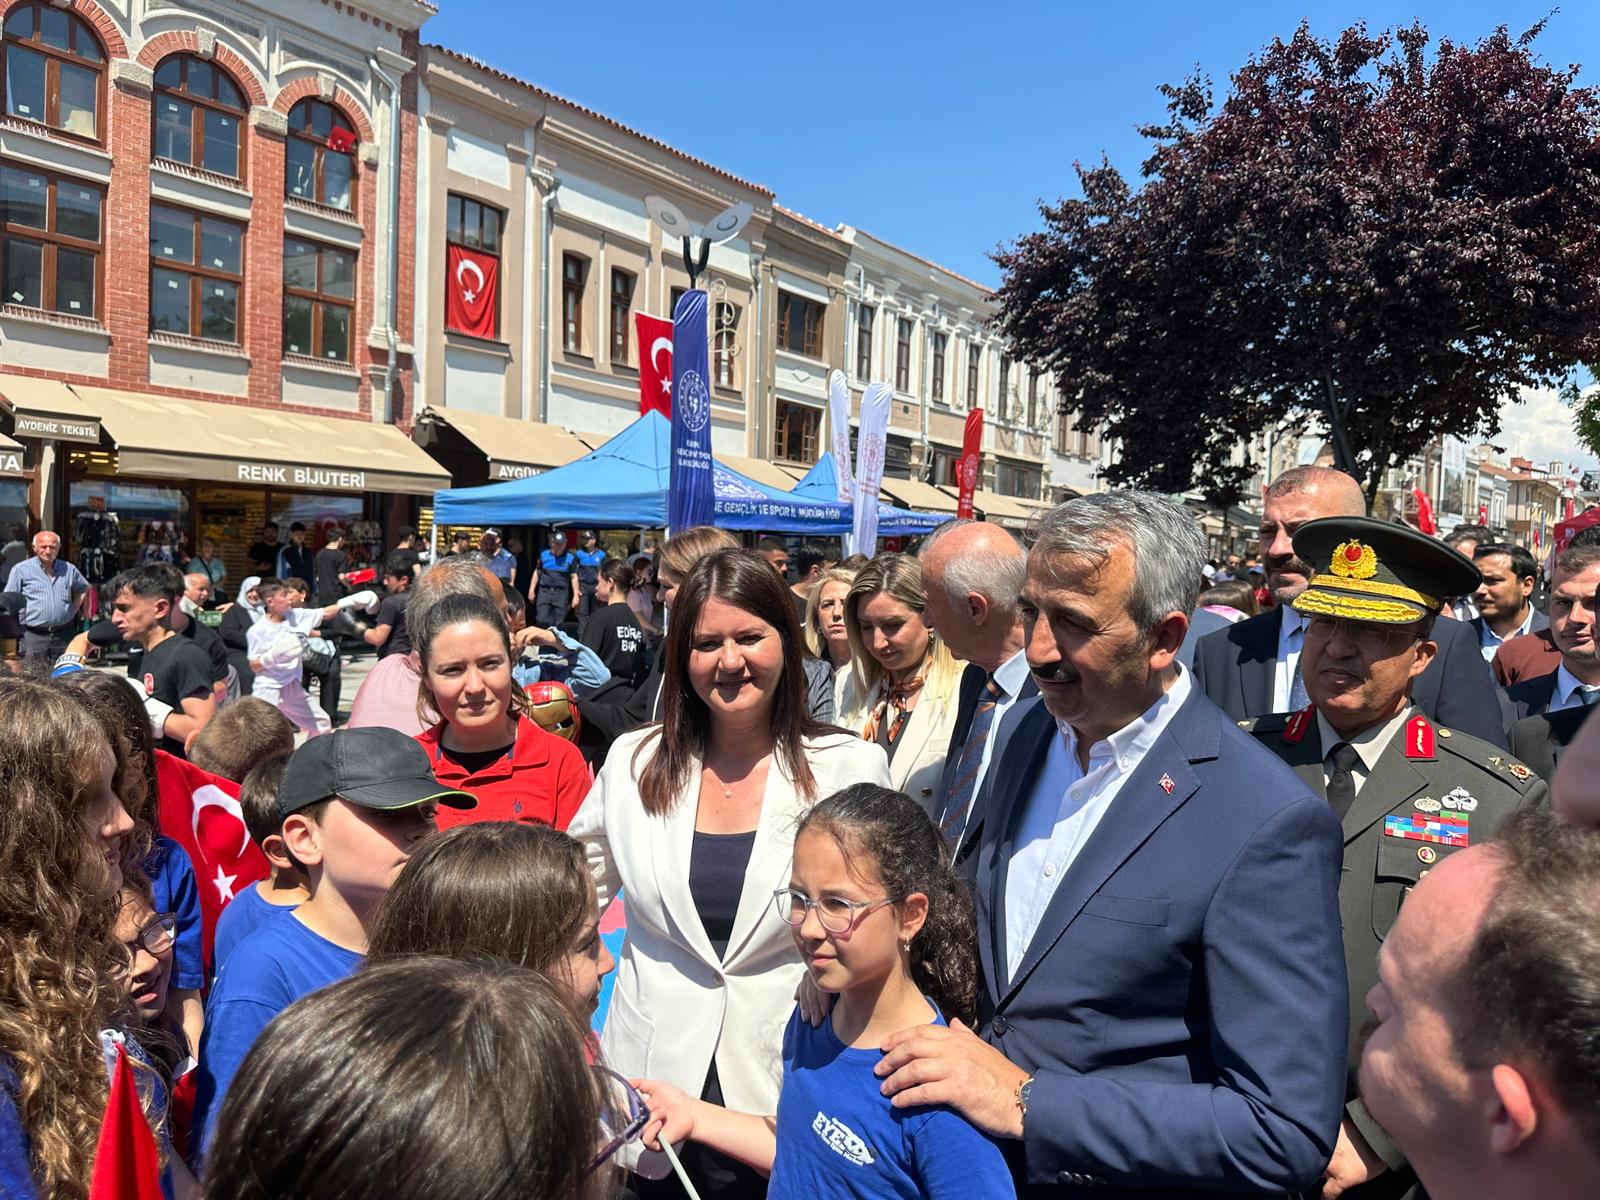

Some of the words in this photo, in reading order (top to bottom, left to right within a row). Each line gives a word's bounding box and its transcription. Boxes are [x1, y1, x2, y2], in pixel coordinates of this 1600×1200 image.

[18, 420, 58, 433] AYDENİZ
[61, 423, 97, 437] TEKSTİL
[237, 464, 287, 483] RENK
[294, 466, 365, 488] BİJUTERİ
[724, 500, 758, 516] GENÇLİK
[758, 504, 769, 516] VE
[769, 504, 790, 517] SPOR
